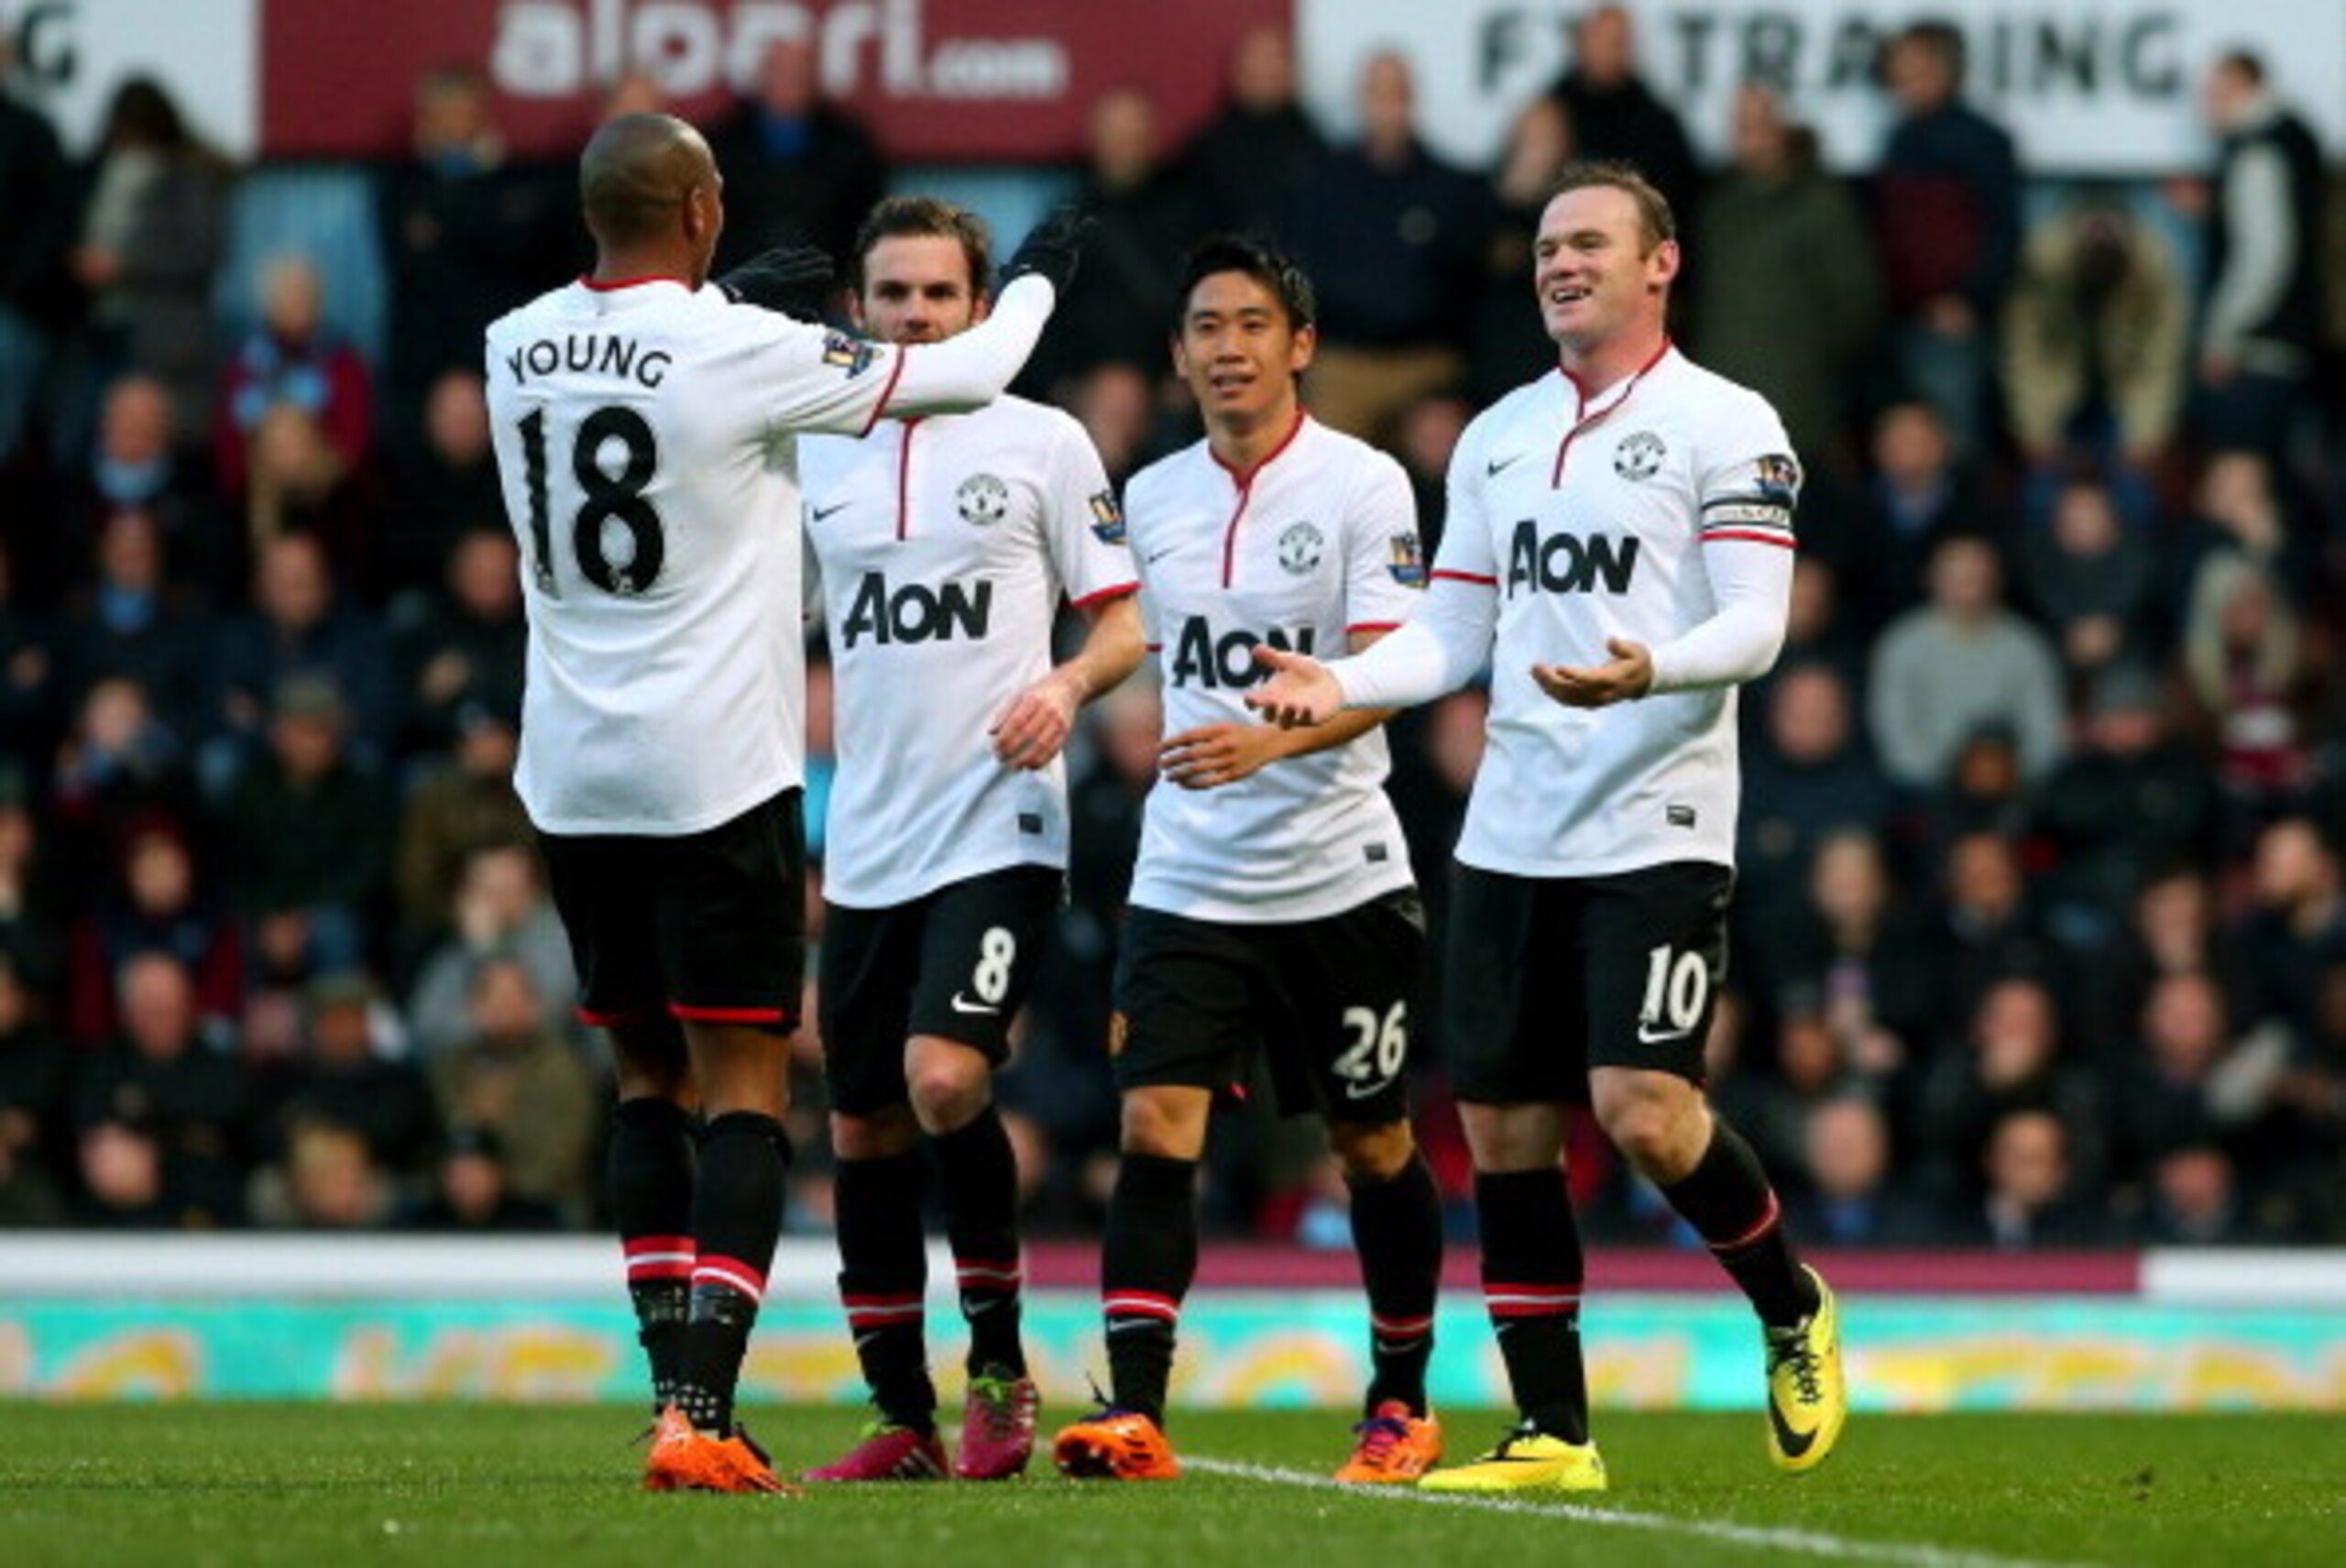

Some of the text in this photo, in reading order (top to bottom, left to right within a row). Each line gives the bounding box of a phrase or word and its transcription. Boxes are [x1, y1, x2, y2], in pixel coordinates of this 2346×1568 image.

[1673, 11, 2185, 97] TRAING
[507, 334, 673, 389] YOUNG
[515, 404, 665, 601] 18
[1507, 518, 1640, 601] AON
[841, 571, 992, 650] AON
[973, 926, 1016, 1004] 8
[1638, 942, 1707, 1030] 10
[1331, 999, 1407, 1080] 26
